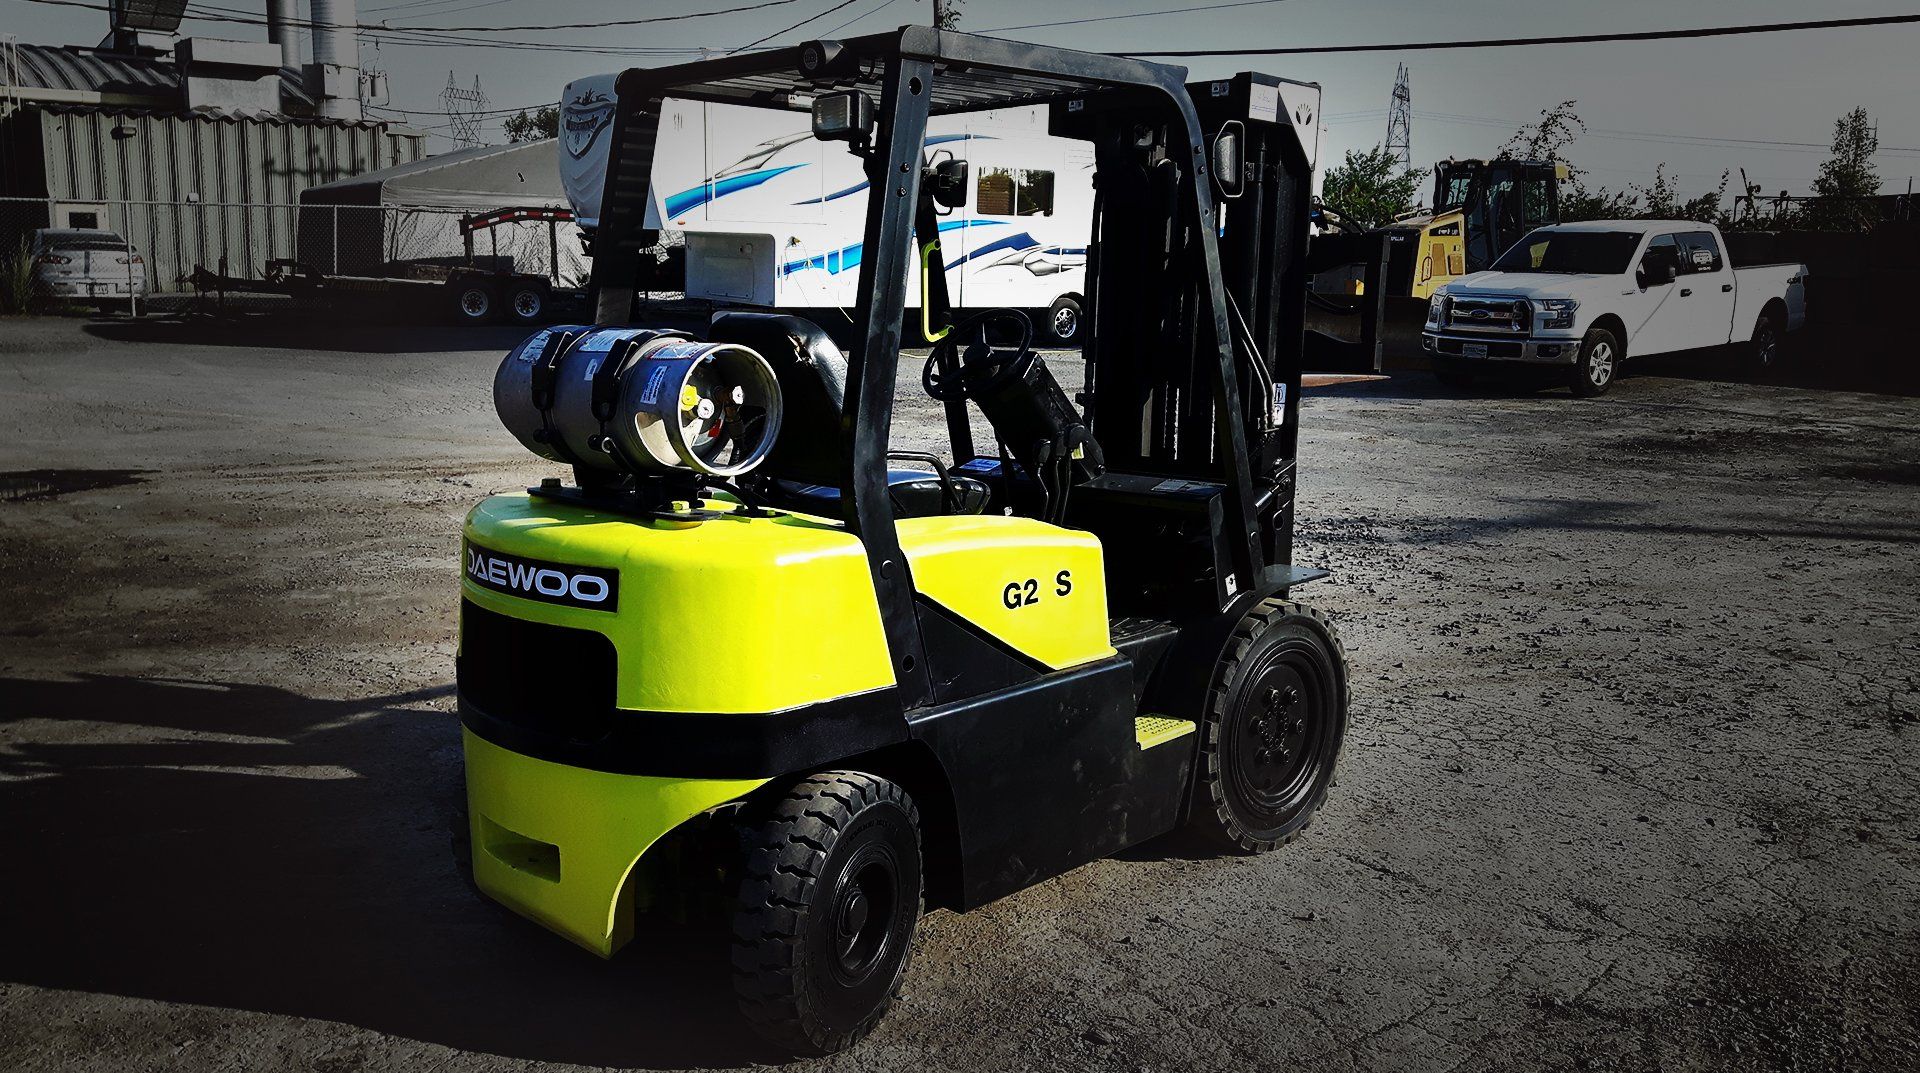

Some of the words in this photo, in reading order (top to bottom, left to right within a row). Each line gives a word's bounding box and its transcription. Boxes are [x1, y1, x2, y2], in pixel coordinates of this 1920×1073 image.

[468, 548, 609, 602] DAEWOO
[1003, 578, 1038, 610] G2
[1056, 570, 1072, 597] S
